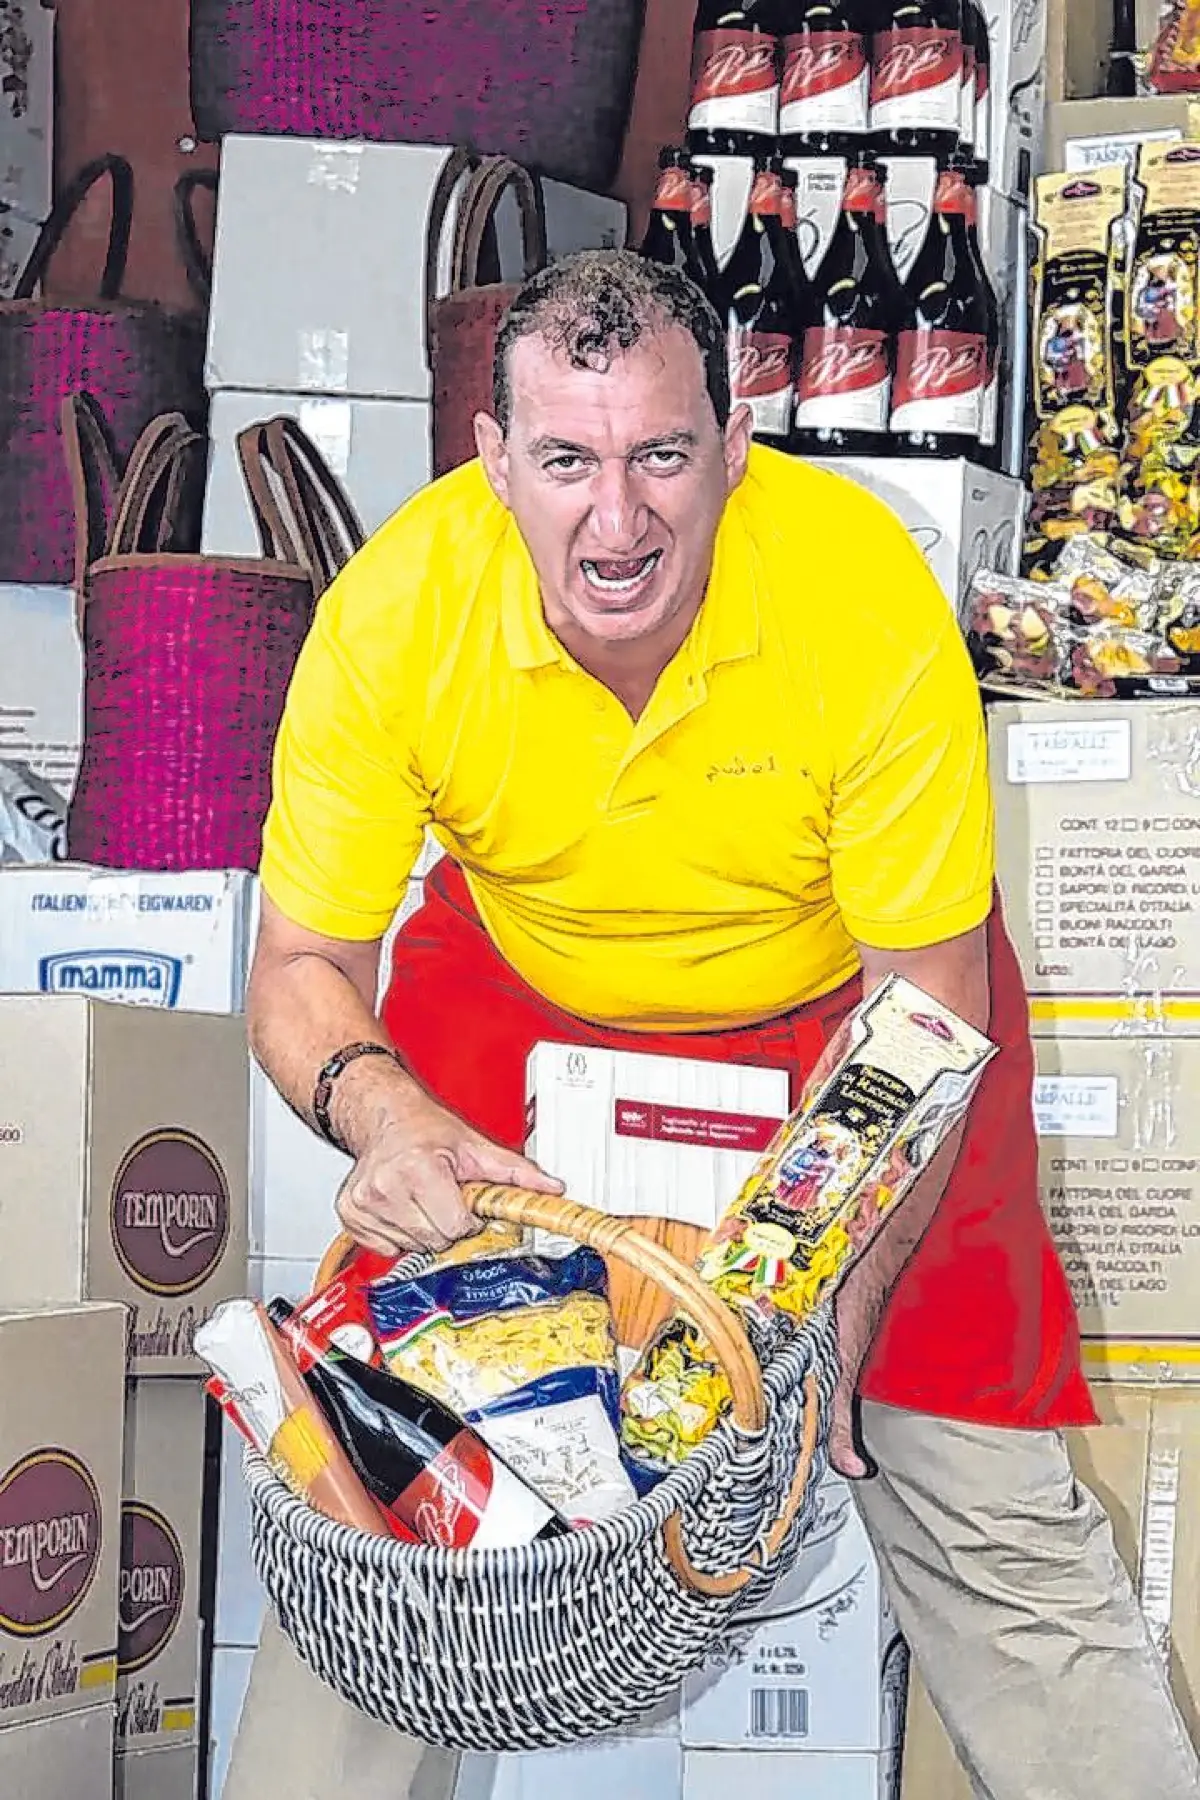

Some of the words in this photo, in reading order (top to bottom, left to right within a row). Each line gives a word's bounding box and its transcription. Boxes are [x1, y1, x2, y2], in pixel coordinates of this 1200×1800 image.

[1139, 865, 1186, 877] GARDA
[138, 895, 213, 911] EIGWAREN
[60, 964, 162, 989] mamma
[1146, 1187, 1192, 1200] CUORE
[121, 1190, 217, 1252] TEMPORIN
[1129, 1279, 1166, 1290] LAGO
[120, 1566, 172, 1610] PORIN
